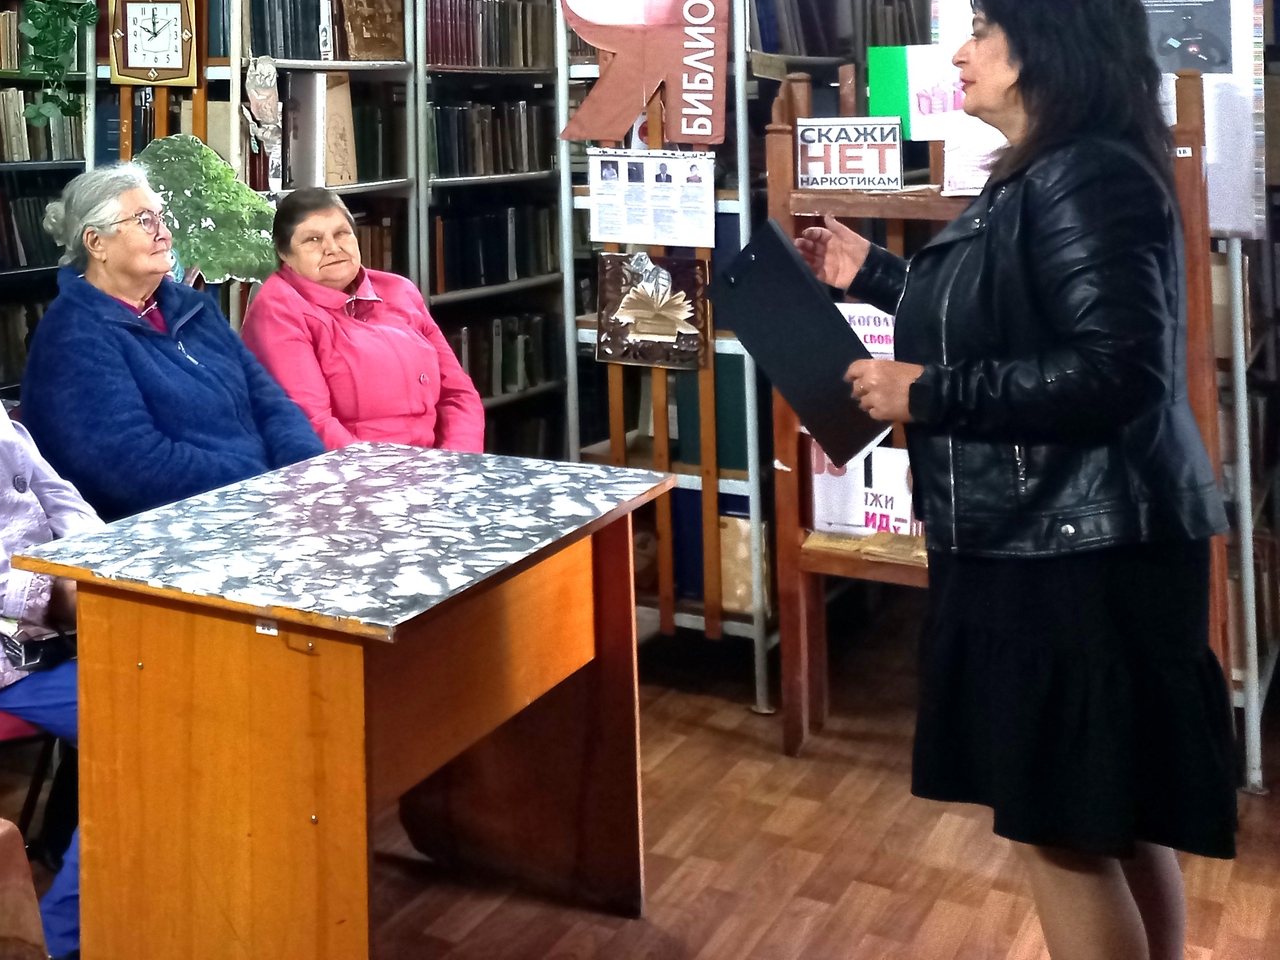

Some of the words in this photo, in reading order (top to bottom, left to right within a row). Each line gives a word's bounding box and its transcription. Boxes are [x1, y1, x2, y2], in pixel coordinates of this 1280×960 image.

[800, 126, 898, 144] СКАЖИ
[800, 144, 898, 175] НЕТ
[800, 176, 899, 186] НАРКОТИКАМ
